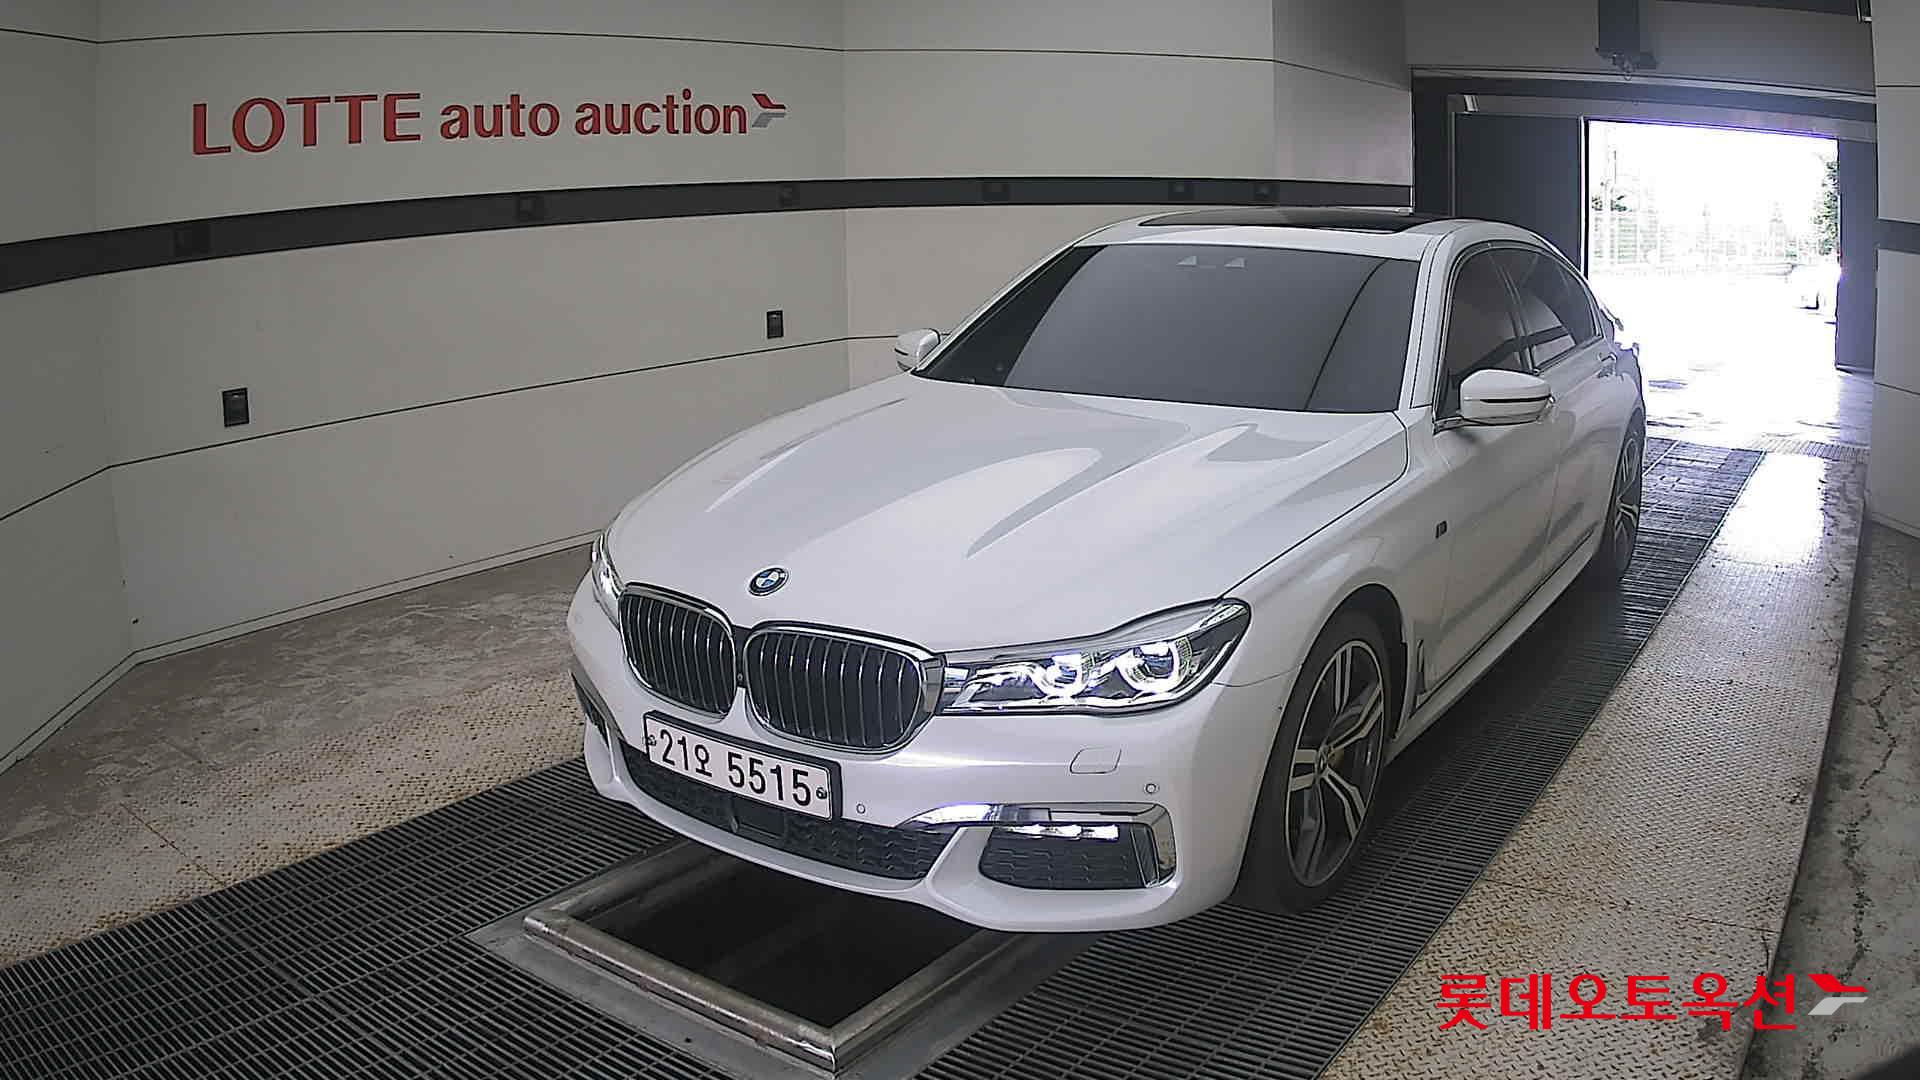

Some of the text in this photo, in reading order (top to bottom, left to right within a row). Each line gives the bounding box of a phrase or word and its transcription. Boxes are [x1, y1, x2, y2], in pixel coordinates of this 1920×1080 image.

[193, 89, 747, 155] LOTTE auto auction
[660, 729, 811, 806] 21오 5515
